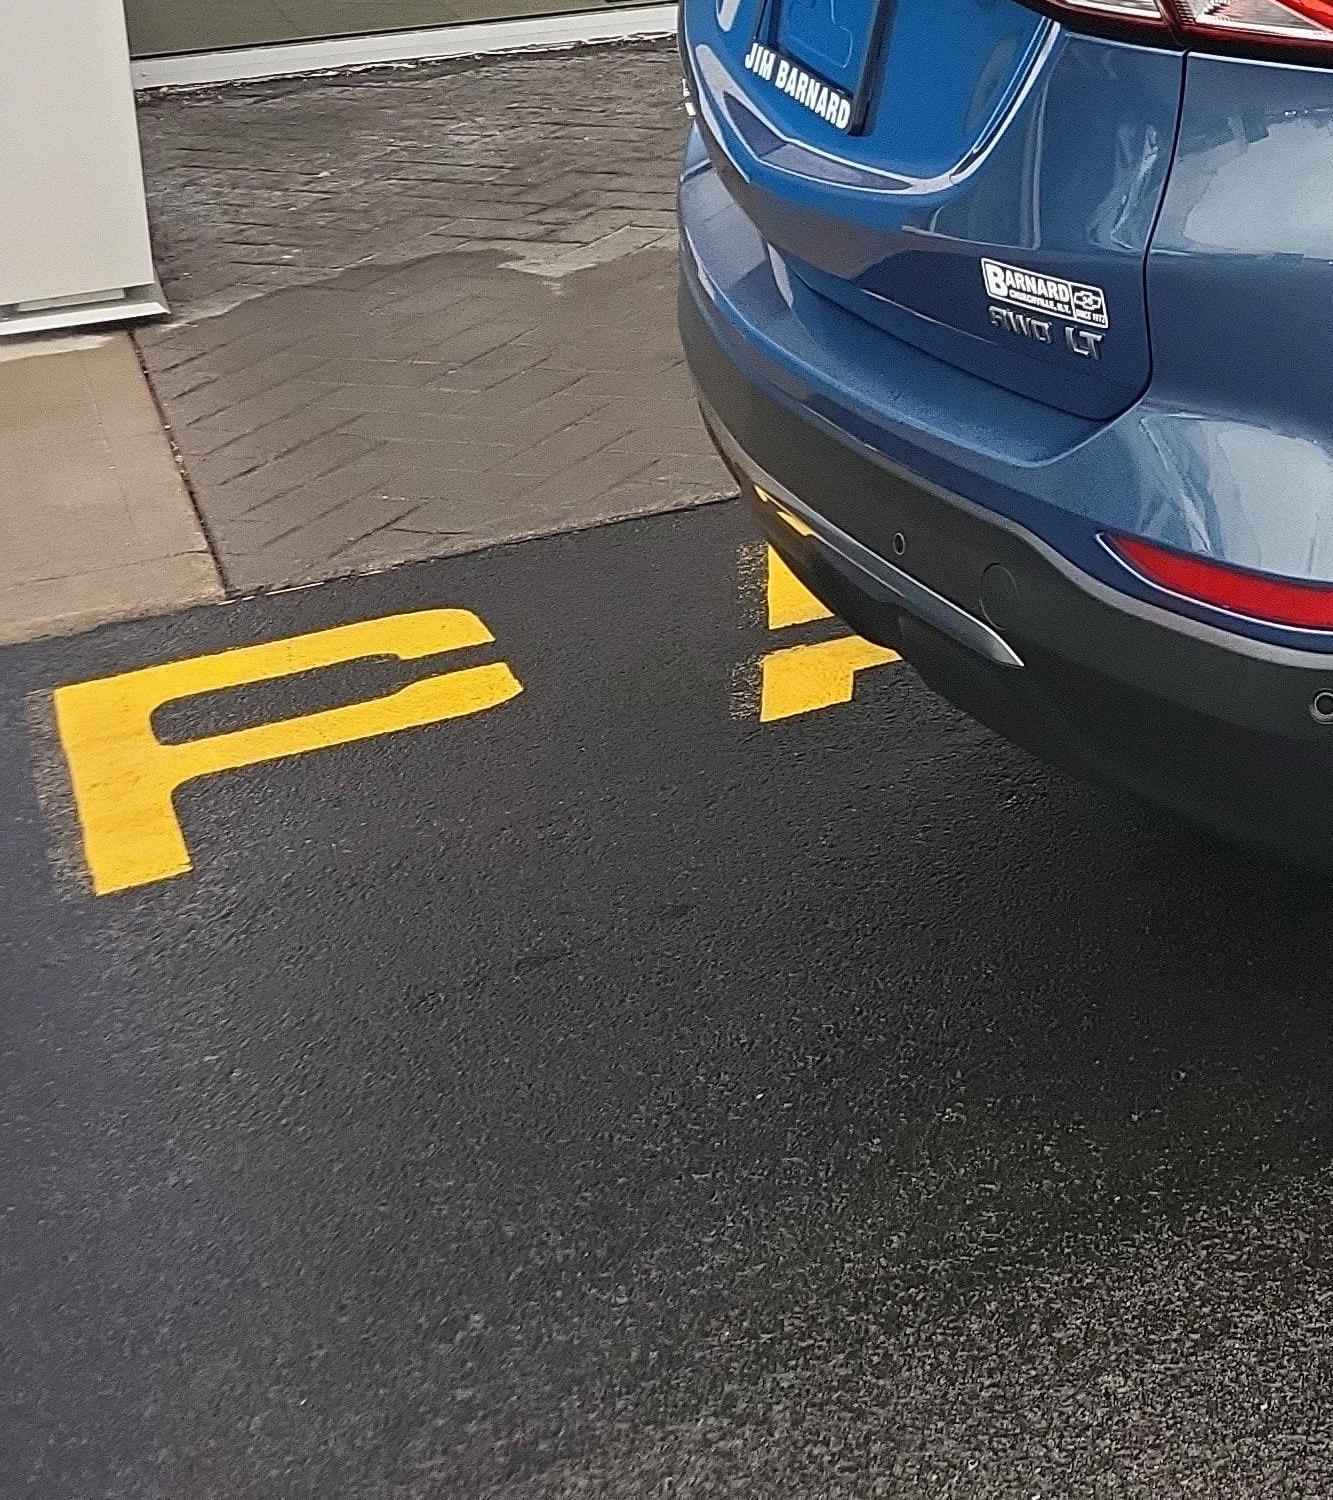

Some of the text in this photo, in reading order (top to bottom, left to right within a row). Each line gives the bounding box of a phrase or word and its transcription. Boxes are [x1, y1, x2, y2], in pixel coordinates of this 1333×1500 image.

[744, 42, 851, 130] JIM BARNARD
[984, 262, 1071, 303] BARNARD
[988, 305, 1106, 361] AWD LT
